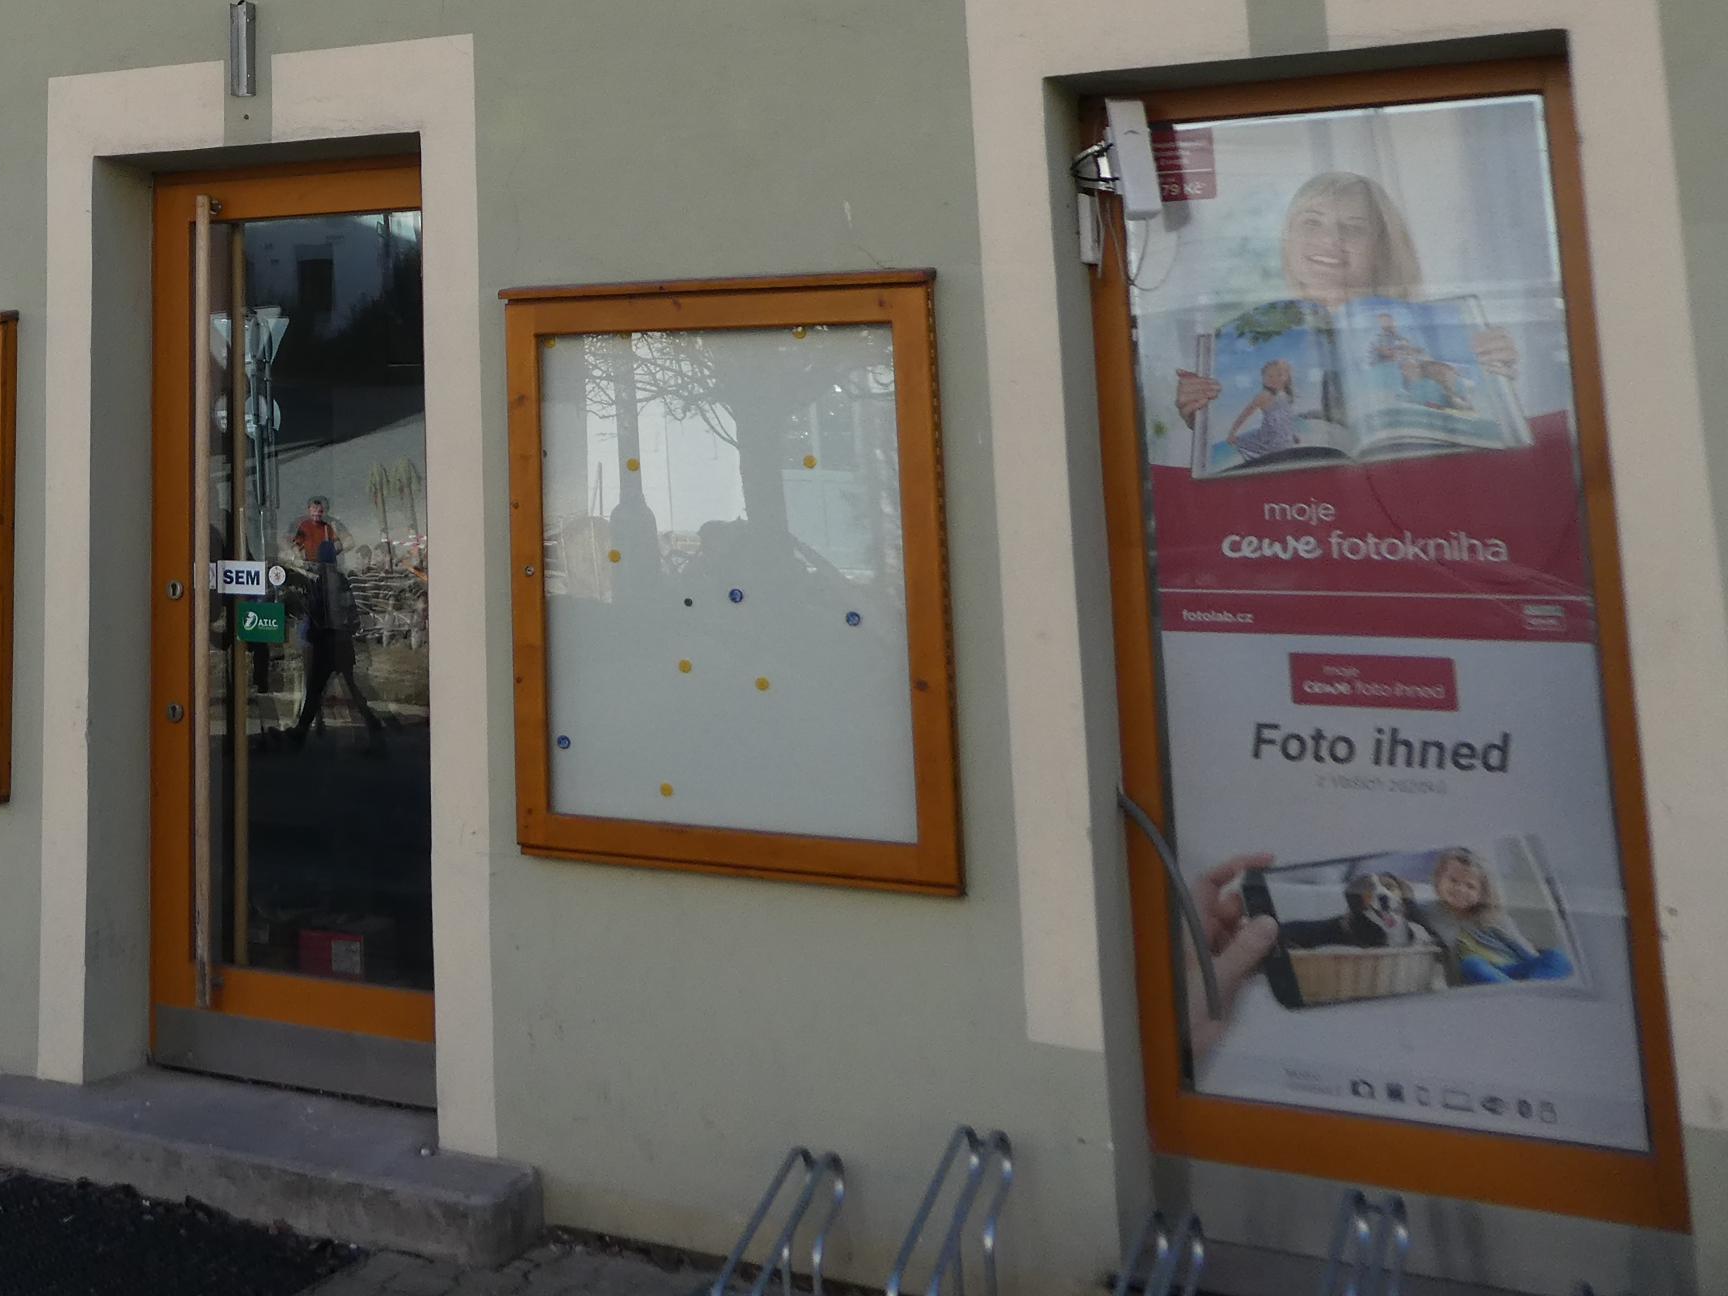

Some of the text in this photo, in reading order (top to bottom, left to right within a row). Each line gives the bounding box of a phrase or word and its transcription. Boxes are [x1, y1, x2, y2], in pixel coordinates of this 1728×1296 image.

[1263, 497, 1336, 526] moje
[1221, 529, 1509, 562] cewe fotokniha
[223, 569, 261, 586] SEM
[1182, 608, 1254, 624] fotolab.cz
[1252, 722, 1511, 773] Foto ihned
